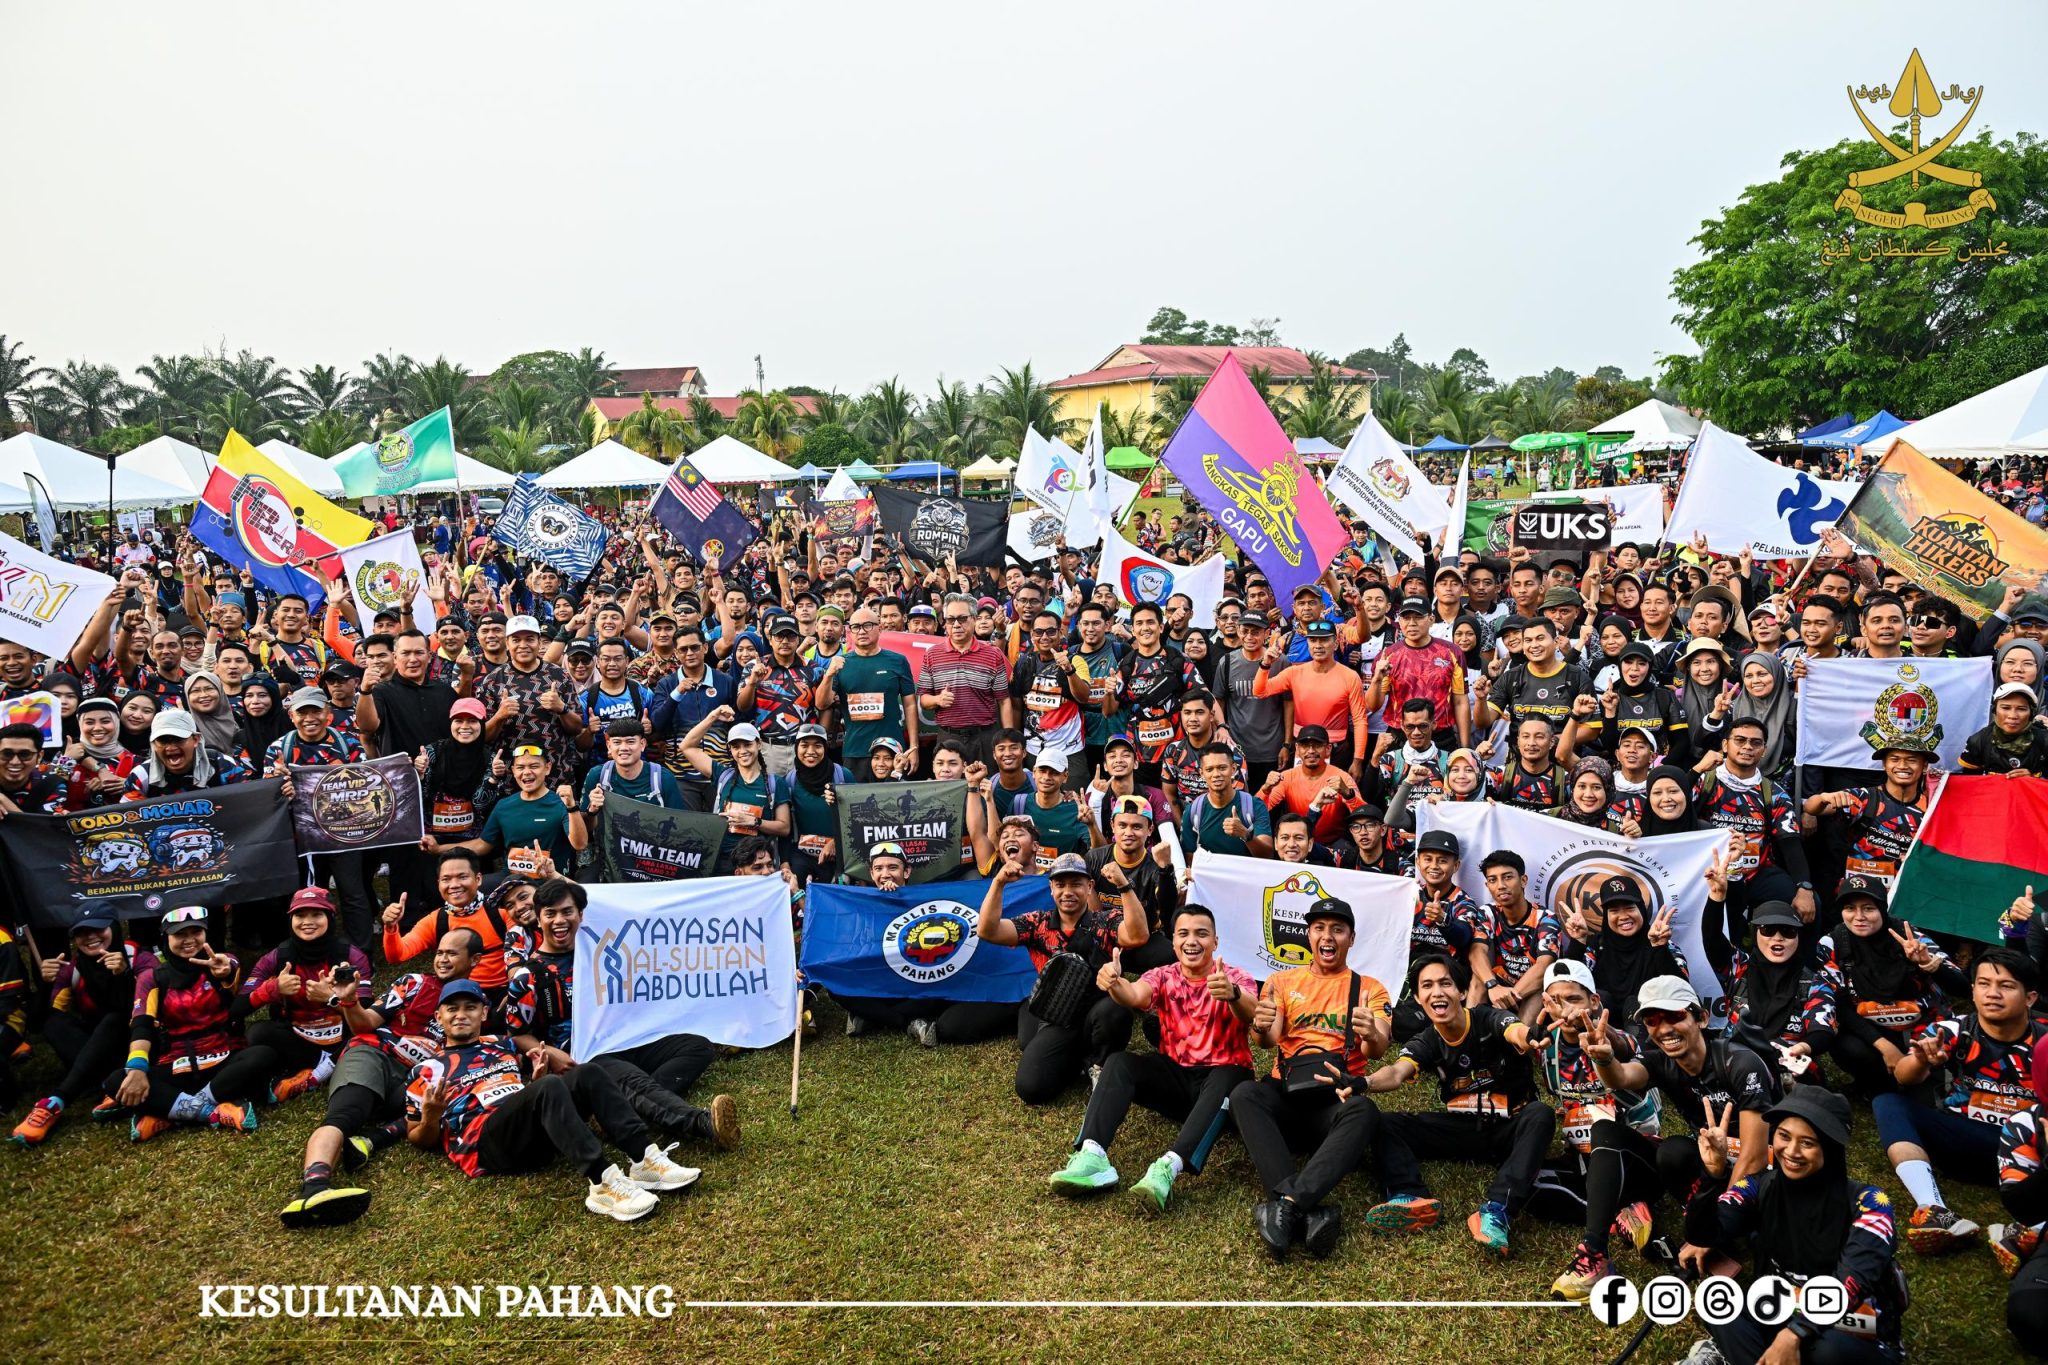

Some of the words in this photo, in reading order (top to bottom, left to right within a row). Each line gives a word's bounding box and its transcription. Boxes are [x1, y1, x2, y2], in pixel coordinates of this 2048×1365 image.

[1340, 465, 1379, 500] KEMENTERIAN
[1204, 457, 1240, 500] TANGKAS
[1243, 501, 1271, 530] TEGAS
[1272, 531, 1300, 565] SAKSAMA
[1345, 478, 1379, 511] PENDIDIKAN
[1377, 508, 1401, 531] DAERAH
[917, 529, 960, 546] ROMPIN
[1220, 508, 1268, 554] GAPU
[1540, 513, 1607, 540] UKS
[1913, 519, 2008, 577] KUANTAN
[1905, 535, 1990, 587] HIKERS
[1881, 549, 1920, 580] STAND
[1920, 576, 1985, 620] TOGETHER
[8, 610, 43, 629] MALAYSIA
[600, 701, 634, 717] MARA
[1514, 705, 1570, 715] MBNP
[1140, 729, 1170, 739] A0091
[1617, 719, 1663, 728] MBNP
[322, 781, 347, 791] TEAM
[348, 779, 367, 789] VIP
[367, 774, 382, 791] 2
[330, 789, 369, 803] MRP
[69, 812, 124, 833] LOAD
[126, 811, 140, 822] &
[141, 800, 213, 820] MOLAR
[863, 825, 899, 843] FMK
[902, 821, 947, 839] TEAM
[620, 836, 655, 858] FMK
[658, 846, 702, 869] TEAM
[915, 855, 931, 863] GAIN
[1582, 840, 1618, 848] BELIA
[1638, 851, 1671, 878] SUKAN
[87, 884, 133, 896] BEBANAN
[134, 881, 166, 891] BUKAN
[167, 878, 189, 887] SATU
[190, 873, 224, 884] ALASAN
[633, 917, 764, 945] YAYASAN
[885, 904, 938, 942] MAJLIS
[634, 944, 766, 974] AL-SULTAN
[901, 963, 956, 980] PAHANG
[633, 967, 768, 1002] ABDULLAH
[1876, 1014, 1916, 1024] 0100
[483, 1084, 520, 1101] A0116
[2002, 1083, 2038, 1098] LASA
